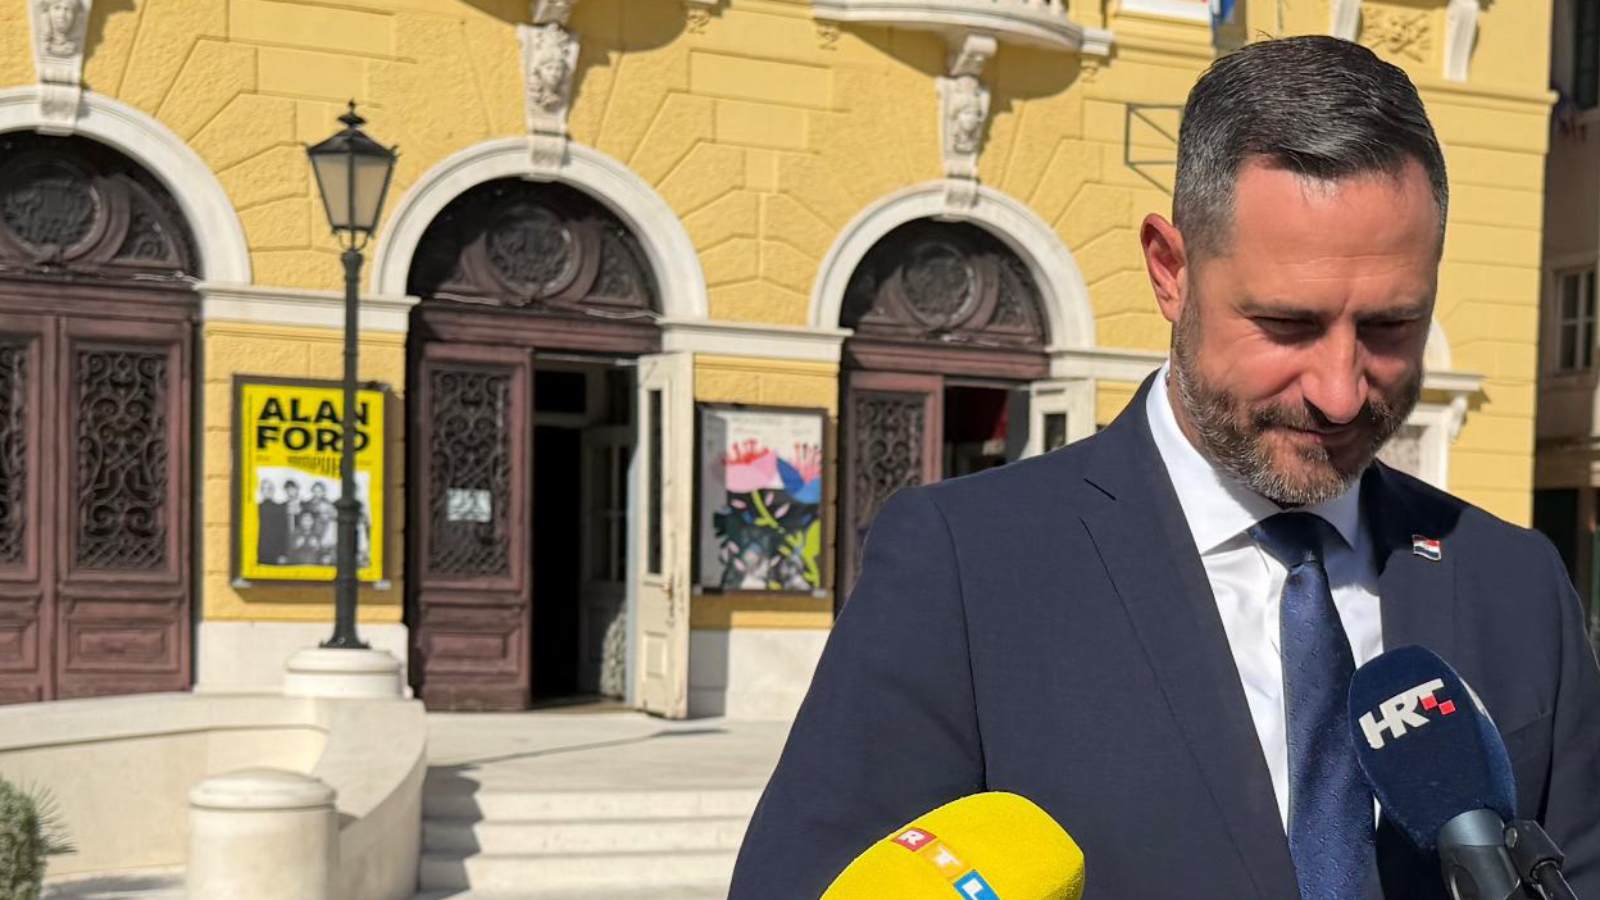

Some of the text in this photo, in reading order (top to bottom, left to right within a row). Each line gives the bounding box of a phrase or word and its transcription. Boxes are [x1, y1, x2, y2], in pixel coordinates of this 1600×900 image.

[258, 397, 369, 425] ALAN
[257, 425, 369, 452] FORD
[1358, 677, 1456, 750] HRT
[896, 828, 985, 900] RTL
